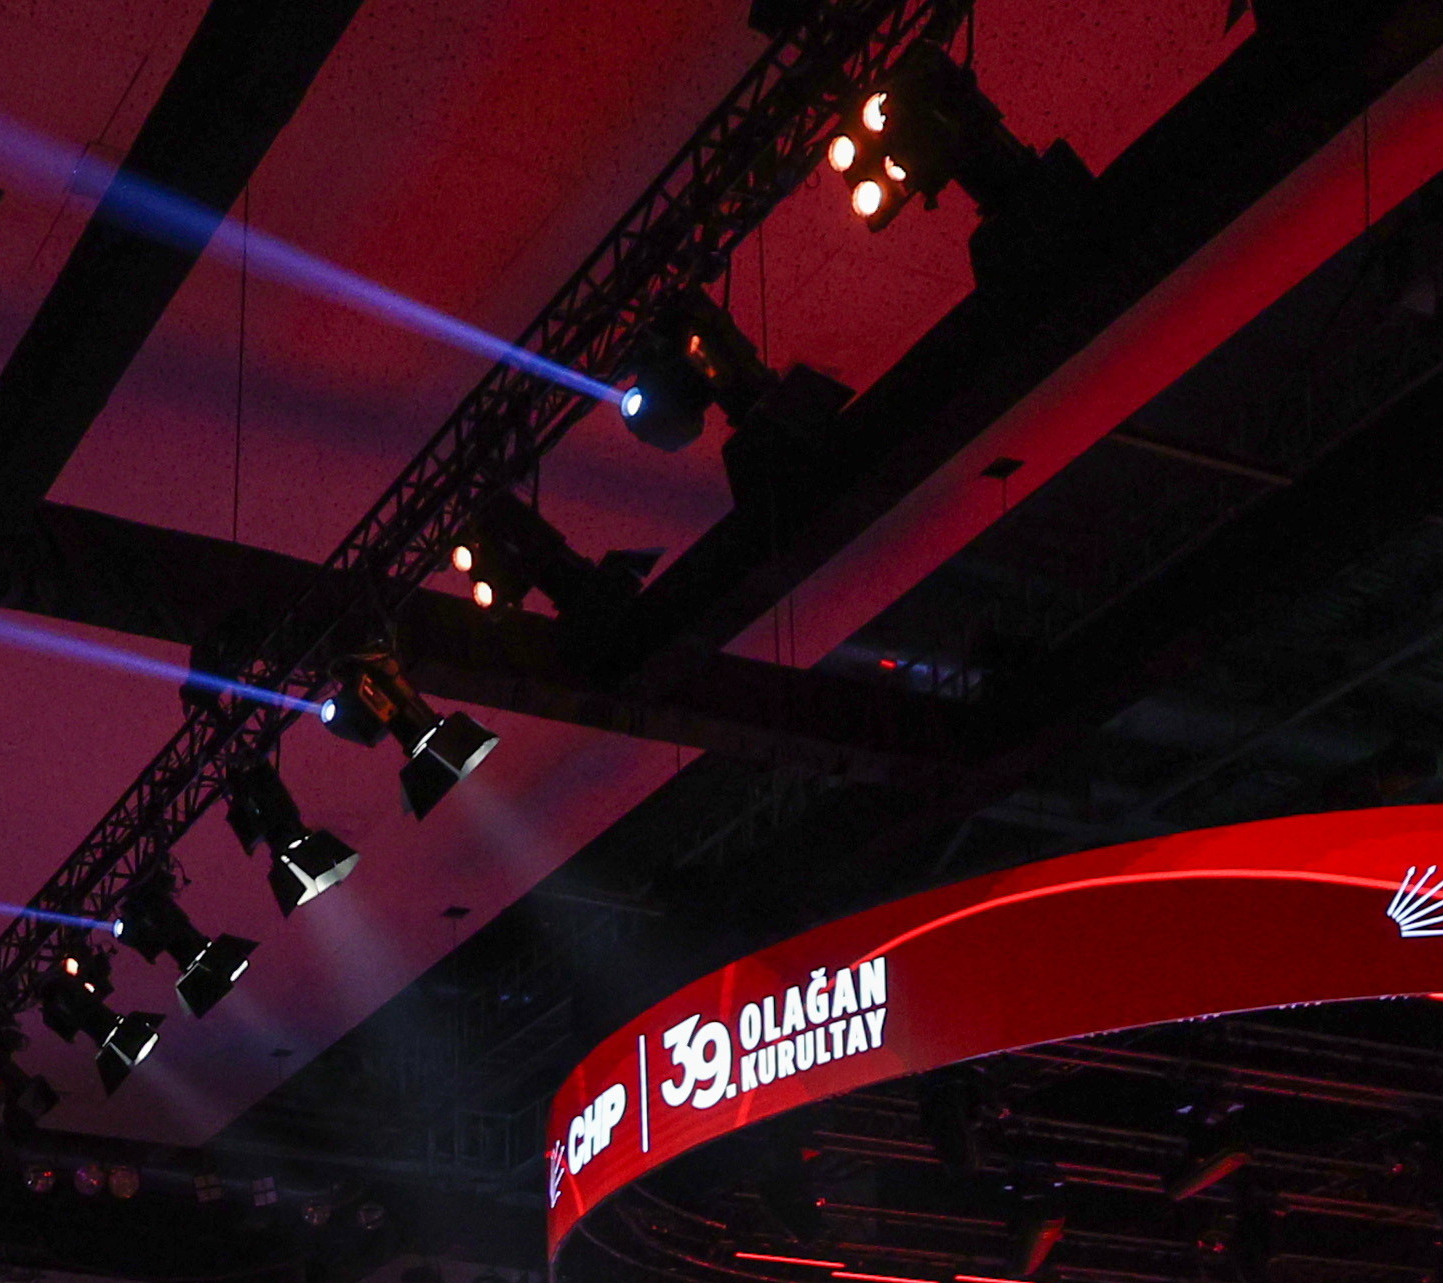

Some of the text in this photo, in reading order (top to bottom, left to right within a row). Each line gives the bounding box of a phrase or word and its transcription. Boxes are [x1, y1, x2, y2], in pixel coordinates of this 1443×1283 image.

[661, 956, 887, 1110] 39. OLAĞAN
[740, 1008, 887, 1092] KURULTAY
[567, 1083, 627, 1175] CHP
